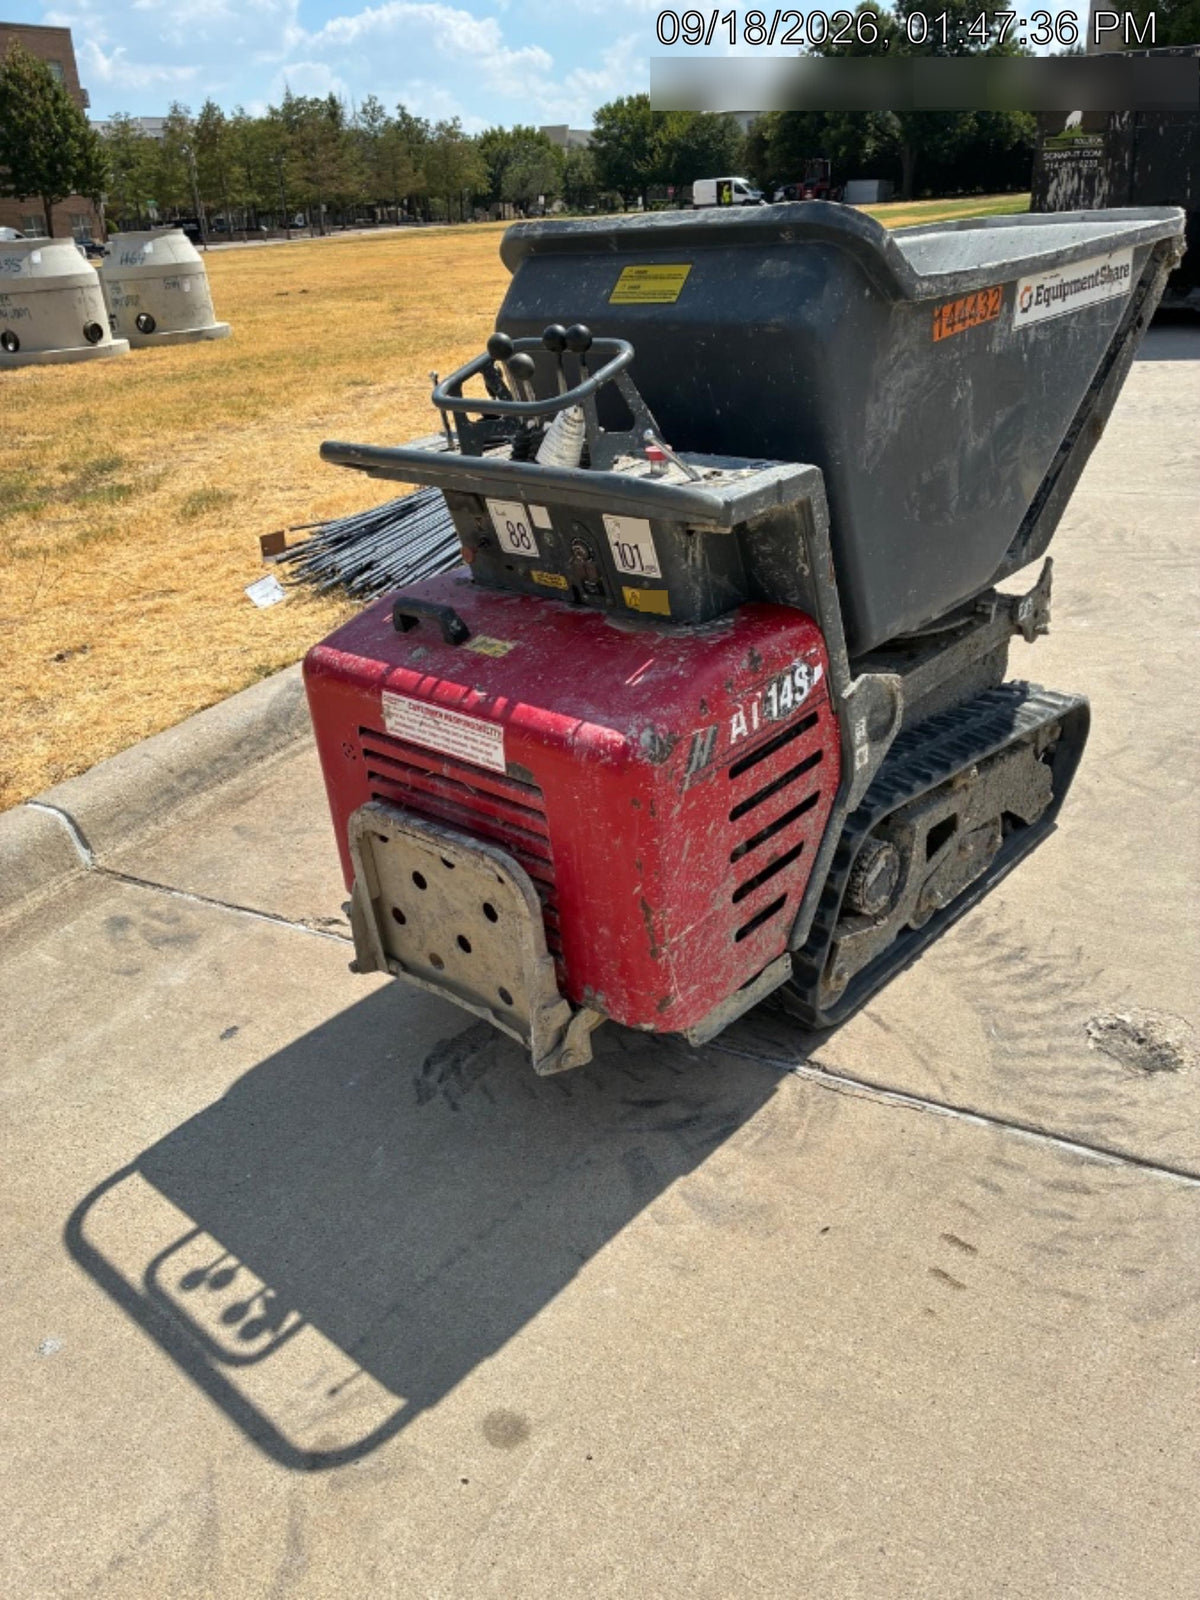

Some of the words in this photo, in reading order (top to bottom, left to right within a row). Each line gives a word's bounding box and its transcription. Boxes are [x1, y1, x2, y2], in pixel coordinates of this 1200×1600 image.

[1034, 263, 1130, 307] EquipmentShare
[934, 289, 1000, 338] 144432
[506, 520, 531, 550] 88
[614, 541, 644, 571] 101
